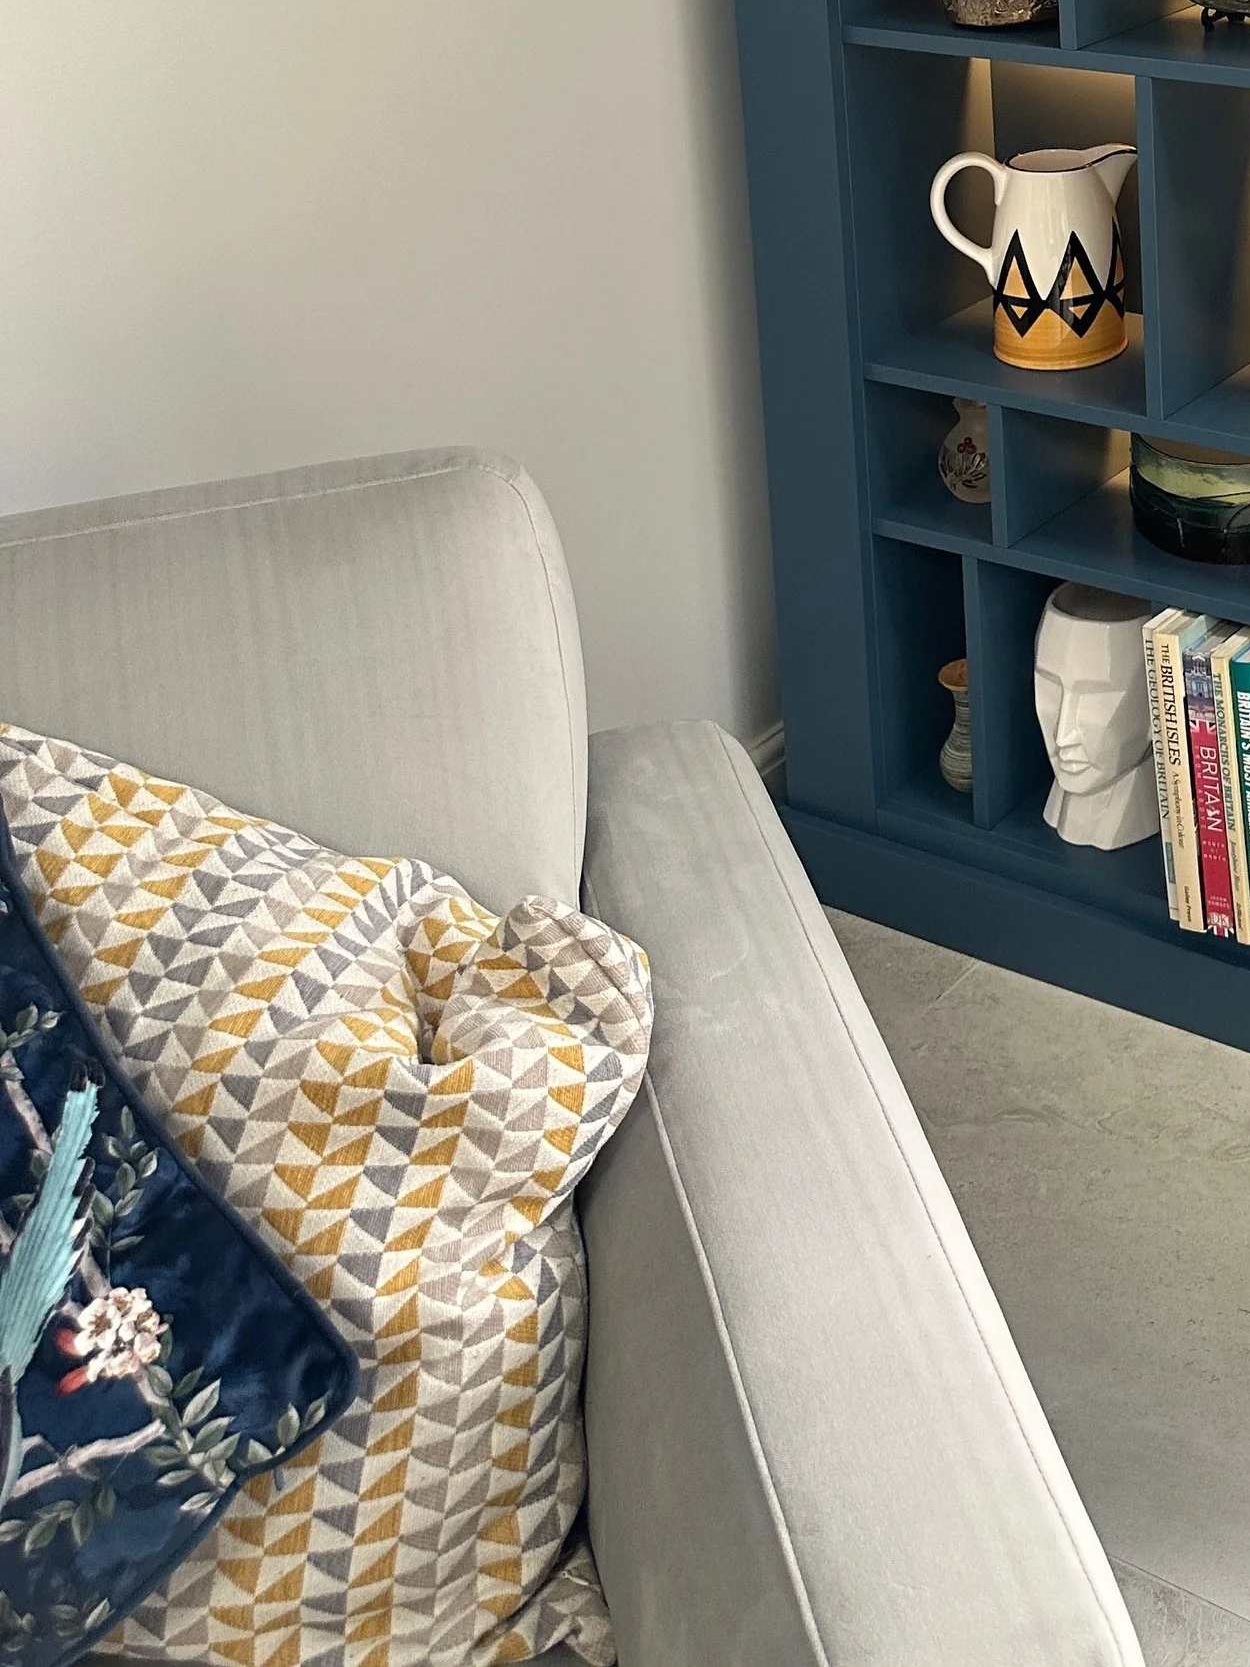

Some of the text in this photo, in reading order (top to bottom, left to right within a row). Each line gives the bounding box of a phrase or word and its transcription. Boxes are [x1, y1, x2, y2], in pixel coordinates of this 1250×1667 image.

[1145, 639, 1169, 819] THE GEOLOGY OF BRITAIN
[1161, 643, 1181, 766] THE BRITISH ISLES
[1213, 672, 1236, 832] THE MONARCHS OF BRITAIN
